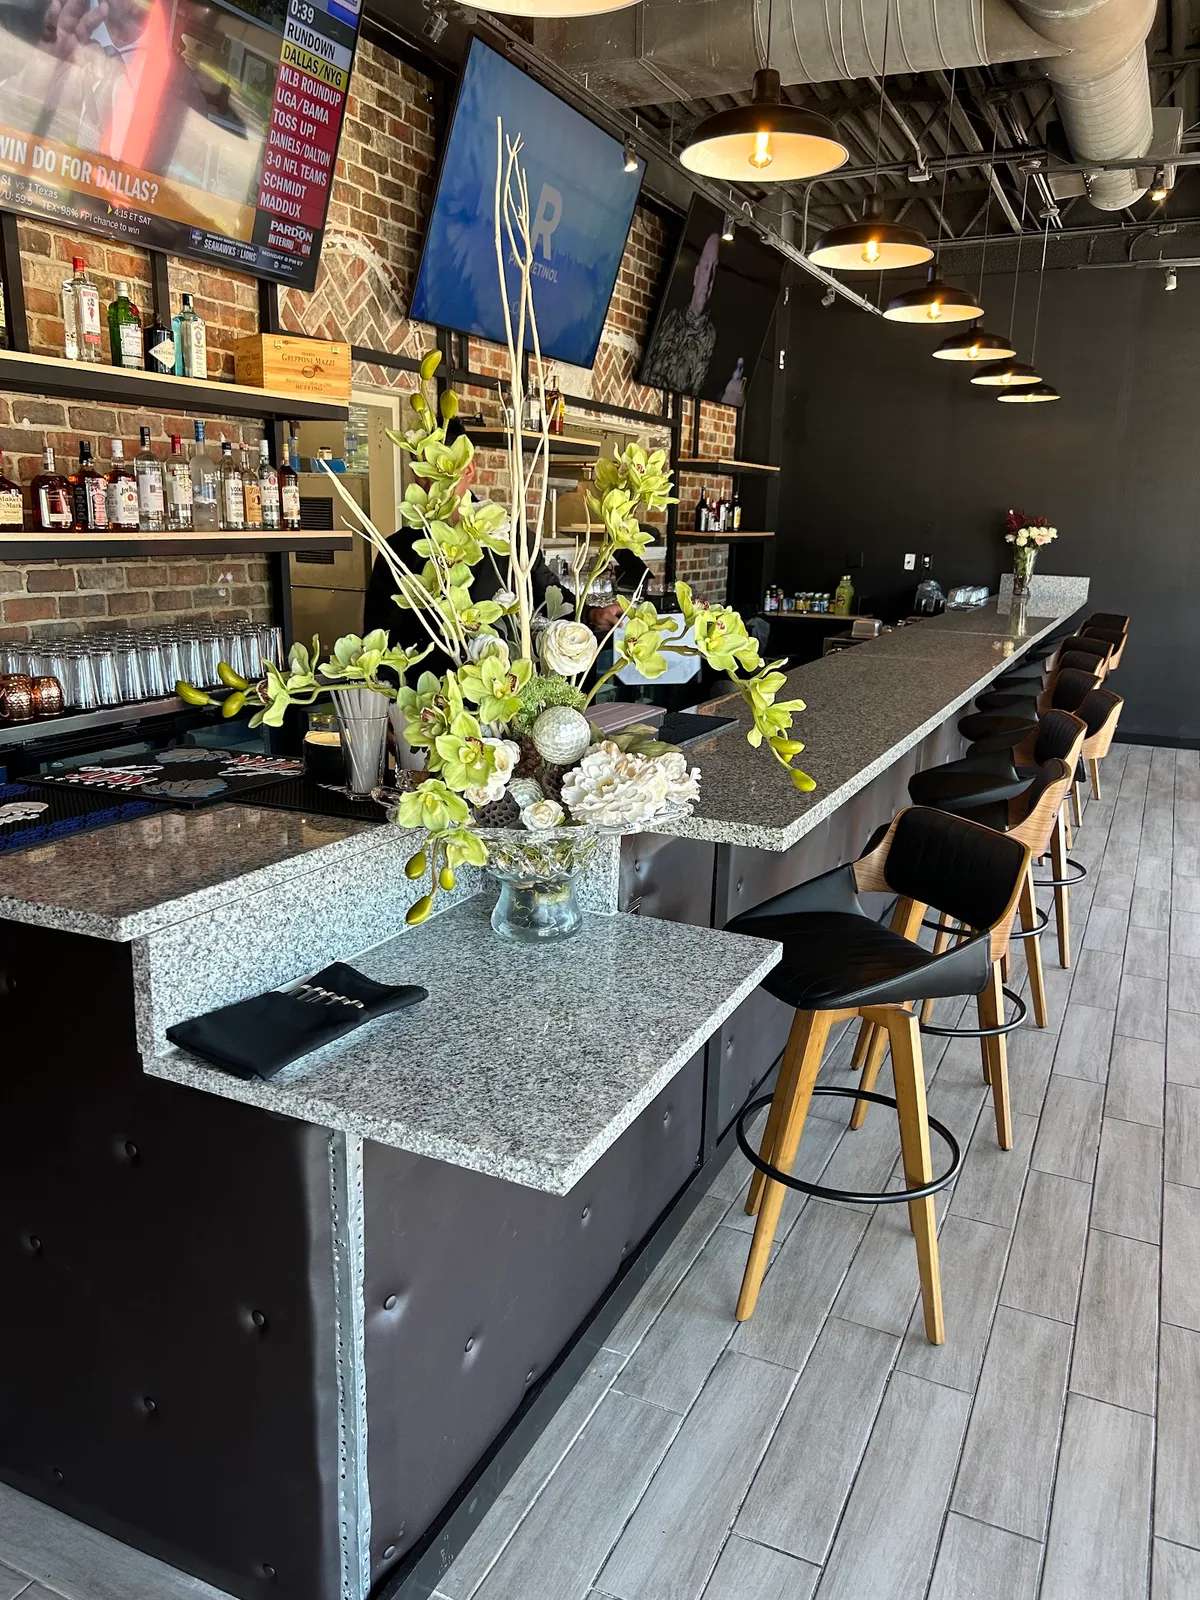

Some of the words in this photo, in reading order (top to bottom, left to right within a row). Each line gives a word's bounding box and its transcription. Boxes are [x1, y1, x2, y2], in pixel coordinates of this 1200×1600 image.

[291, 0, 314, 24] 0:39
[287, 22, 336, 60] RUNDOWN
[283, 45, 342, 86] DALLAS/NYG
[280, 65, 300, 88] MLB
[301, 76, 342, 107] ROUNDUP
[277, 87, 329, 125] UGA/BAMA
[273, 108, 298, 132] TOSS
[300, 120, 317, 140] UP!
[269, 129, 331, 168] DANIELS/DALTON
[32, 145, 56, 173] DO
[61, 154, 93, 184] FOR
[95, 165, 159, 204] DALLAS?
[266, 151, 282, 169] 3-0
[283, 157, 298, 176] NFL
[300, 163, 327, 187] TEAMS
[28, 182, 32, 192] 1
[34, 183, 58, 199] Texas
[263, 171, 307, 200] SCHMIDT
[15, 193, 33, 206] 59.5
[41, 199, 60, 213] TEX:
[60, 205, 79, 219] 98%
[93, 215, 119, 230] chance
[119, 223, 127, 232] to
[128, 224, 140, 235] win
[114, 208, 128, 220] 4:15
[129, 212, 137, 222] ET
[138, 215, 152, 226] SAT
[260, 191, 302, 219] MADDUX
[270, 220, 314, 243] PARDON
[531, 182, 563, 261] R
[203, 238, 237, 257] SEAHAWKS
[240, 249, 257, 262] LIONS
[261, 250, 284, 261] MONDAY
[281, 353, 315, 364] GREPPONE
[315, 357, 335, 367] MAZZI
